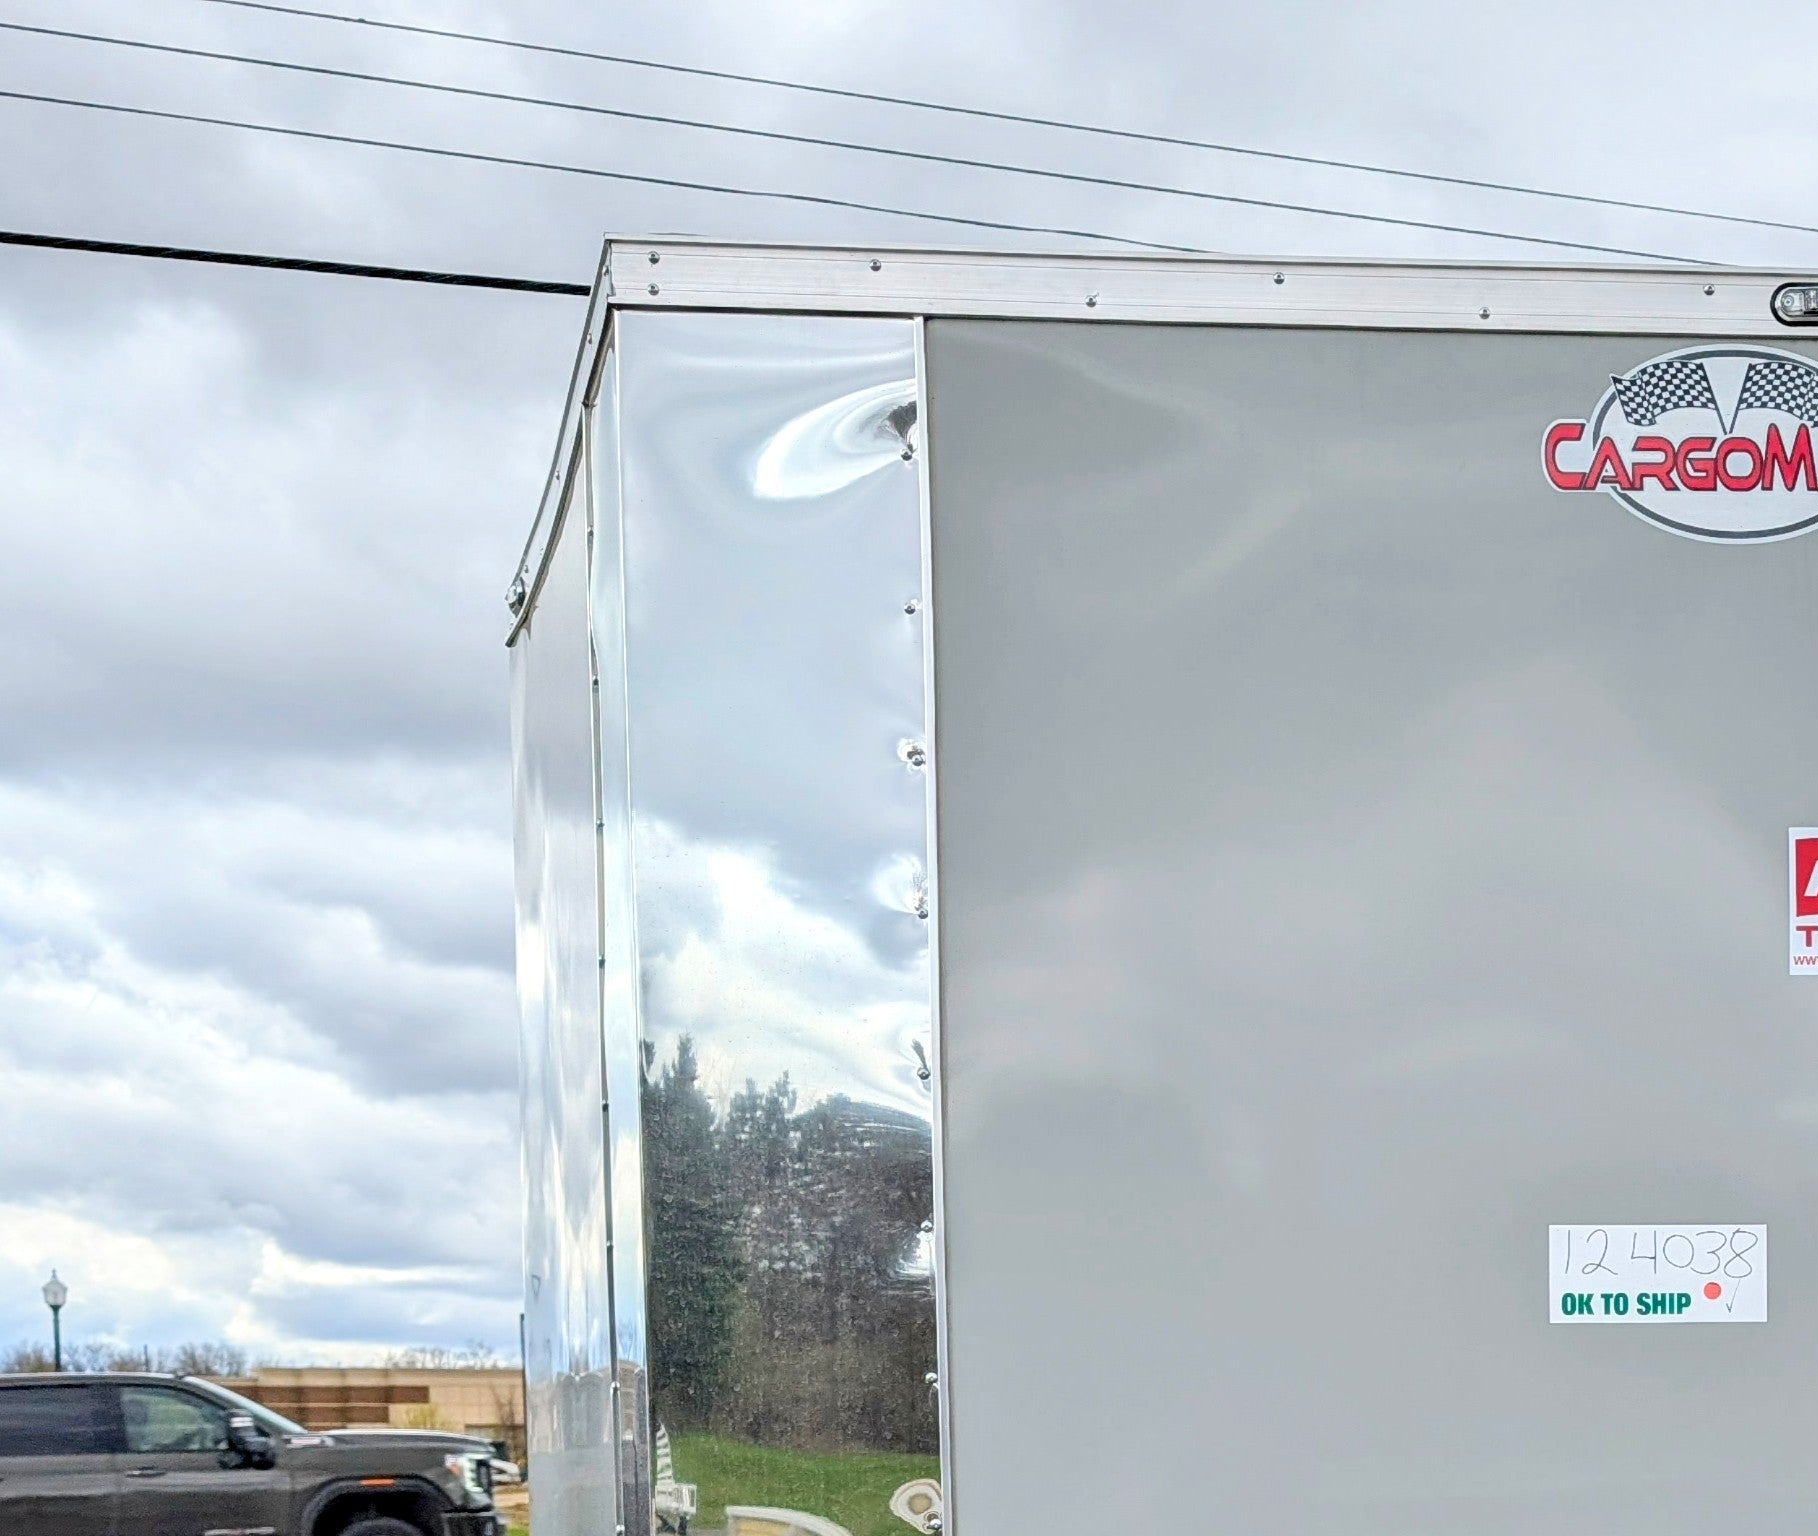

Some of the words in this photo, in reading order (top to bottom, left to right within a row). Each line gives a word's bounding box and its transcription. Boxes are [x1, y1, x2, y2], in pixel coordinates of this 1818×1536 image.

[1561, 1293, 1593, 1316] OK
[1600, 1293, 1630, 1315] TO
[1636, 1292, 1692, 1315] SHIP
